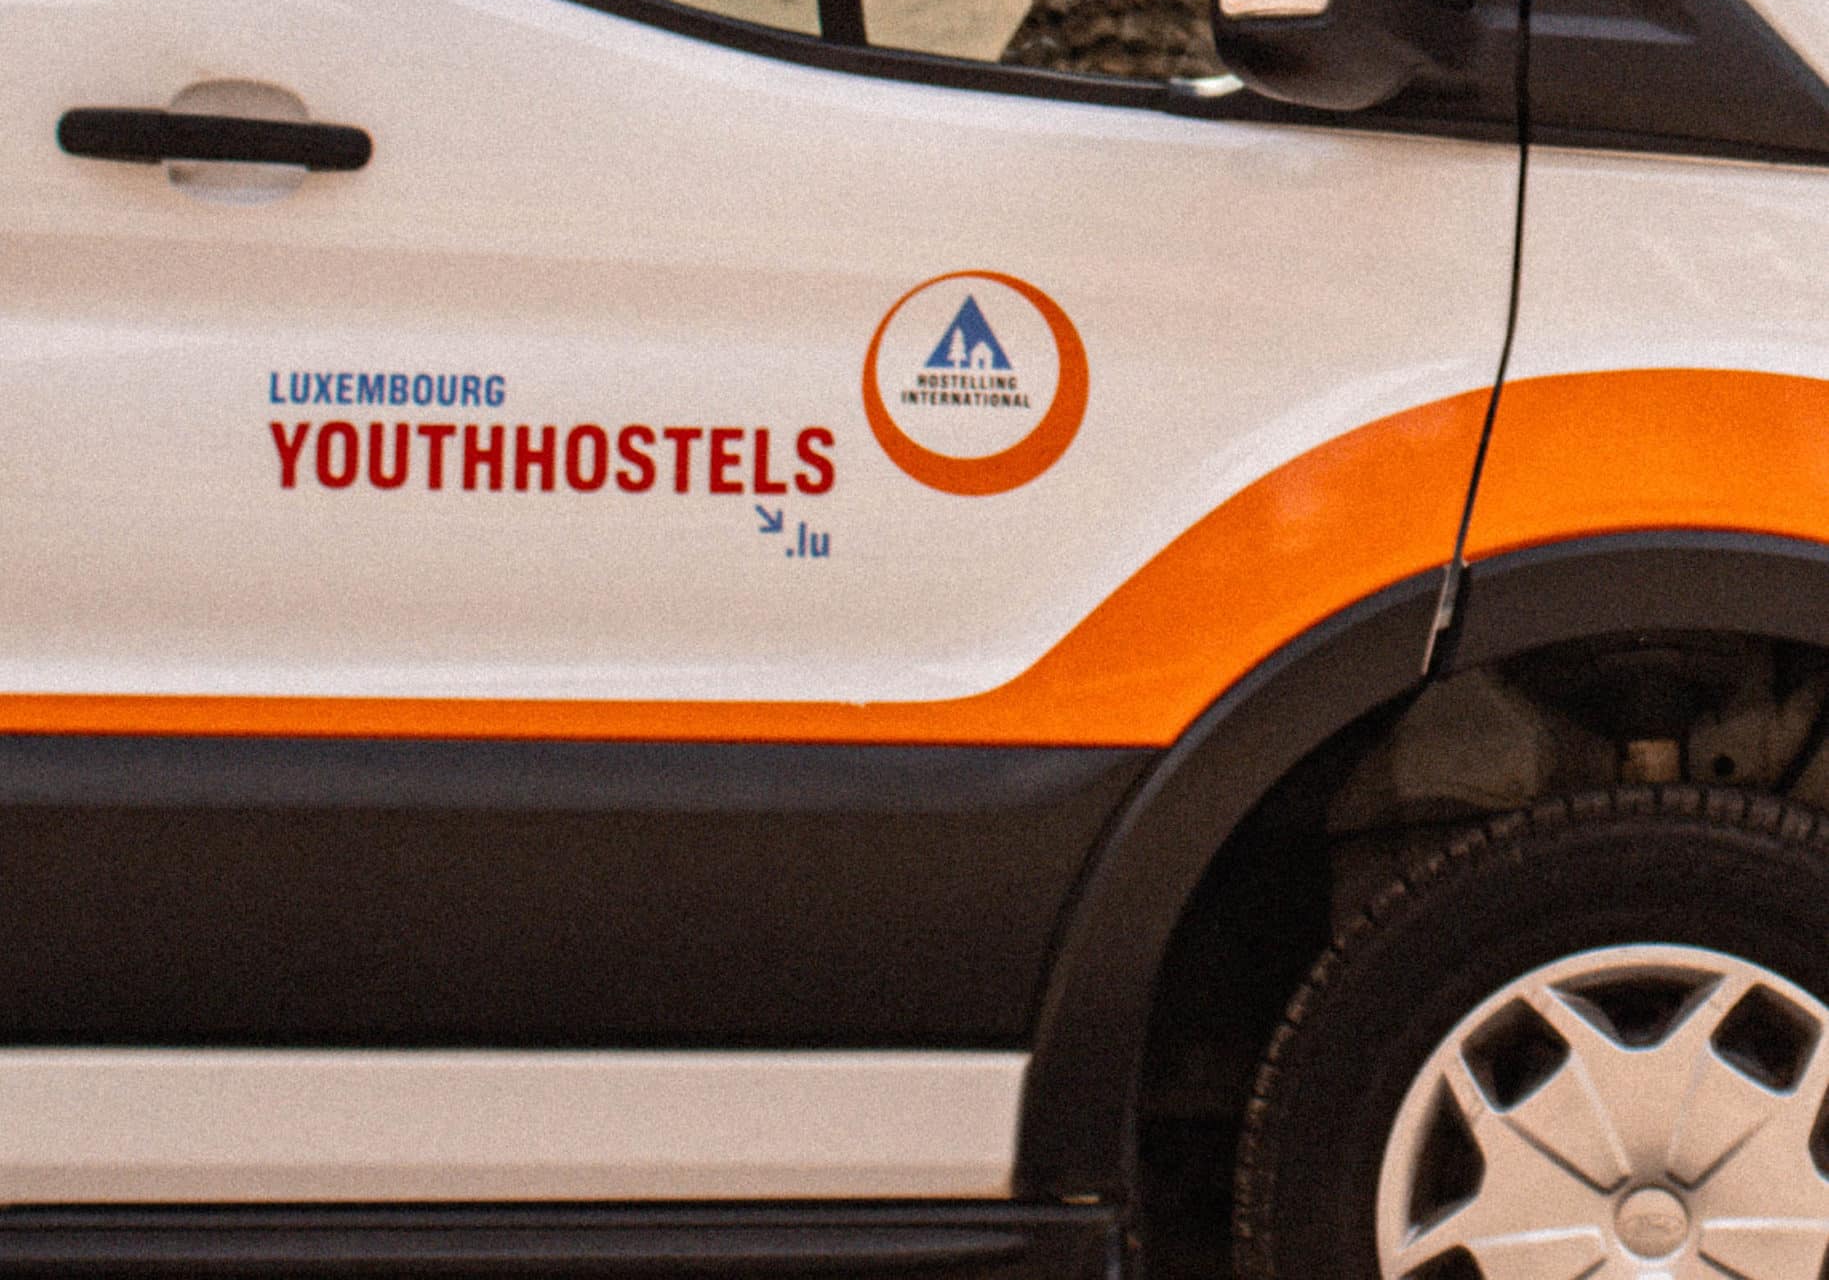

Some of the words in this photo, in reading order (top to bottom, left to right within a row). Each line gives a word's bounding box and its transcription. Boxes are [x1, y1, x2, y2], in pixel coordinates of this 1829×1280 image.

[269, 371, 506, 407] LUXEMBOURG
[901, 391, 1030, 408] INTERNATIONAL
[917, 374, 1018, 390] HOSTELLING
[269, 420, 836, 495] YOUTHHOSTELS
[785, 522, 831, 558] .lu
